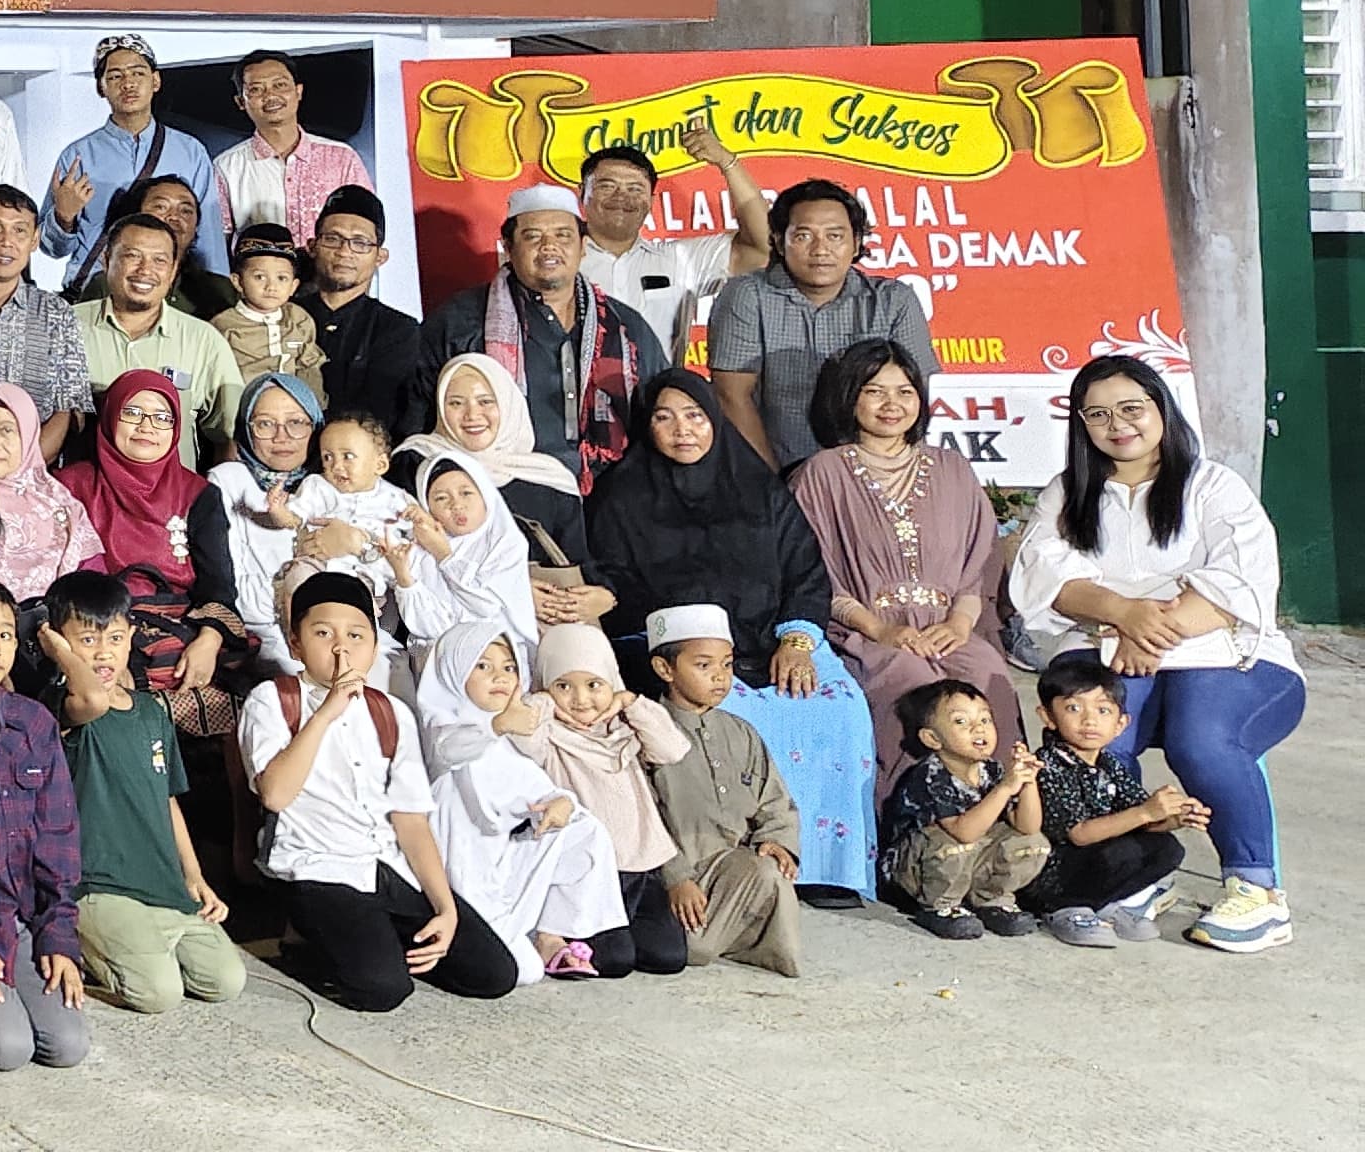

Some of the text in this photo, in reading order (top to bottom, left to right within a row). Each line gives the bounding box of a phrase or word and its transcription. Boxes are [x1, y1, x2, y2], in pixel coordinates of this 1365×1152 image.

[734, 91, 803, 143] dan
[823, 93, 960, 156] Sukses
[927, 230, 1088, 268] DEMAK
